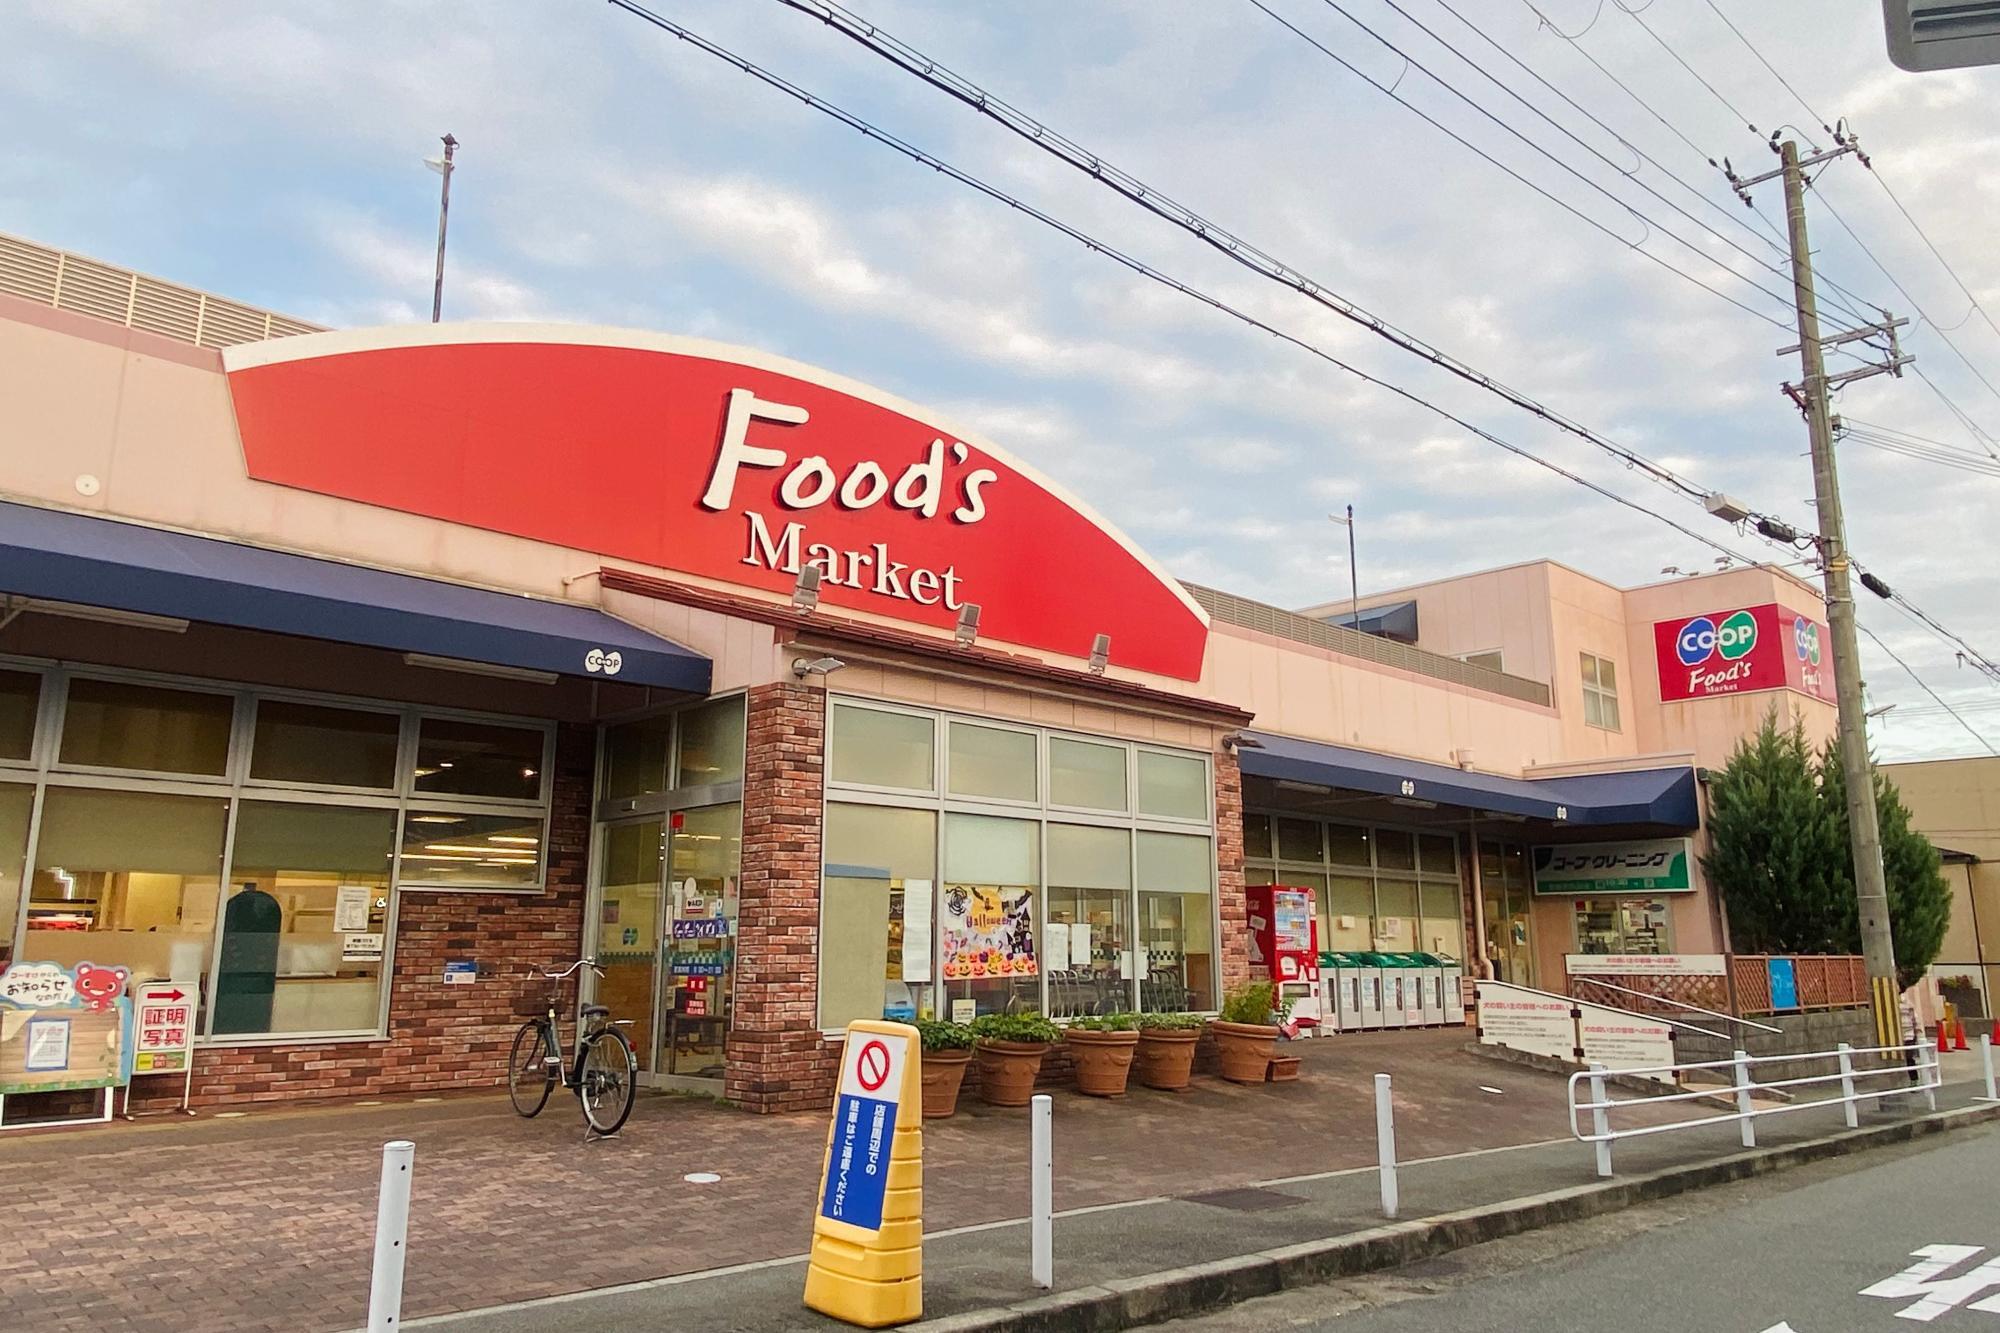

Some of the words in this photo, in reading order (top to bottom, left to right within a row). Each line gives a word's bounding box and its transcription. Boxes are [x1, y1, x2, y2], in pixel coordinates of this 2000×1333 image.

[702, 387, 998, 523] Food's
[742, 510, 964, 611] Market
[1688, 661, 1753, 694] Food's
[1705, 682, 1738, 694] Market
[7, 979, 67, 996] お知らせ
[145, 1008, 187, 1025] 証明
[143, 1029, 186, 1047] 写真
